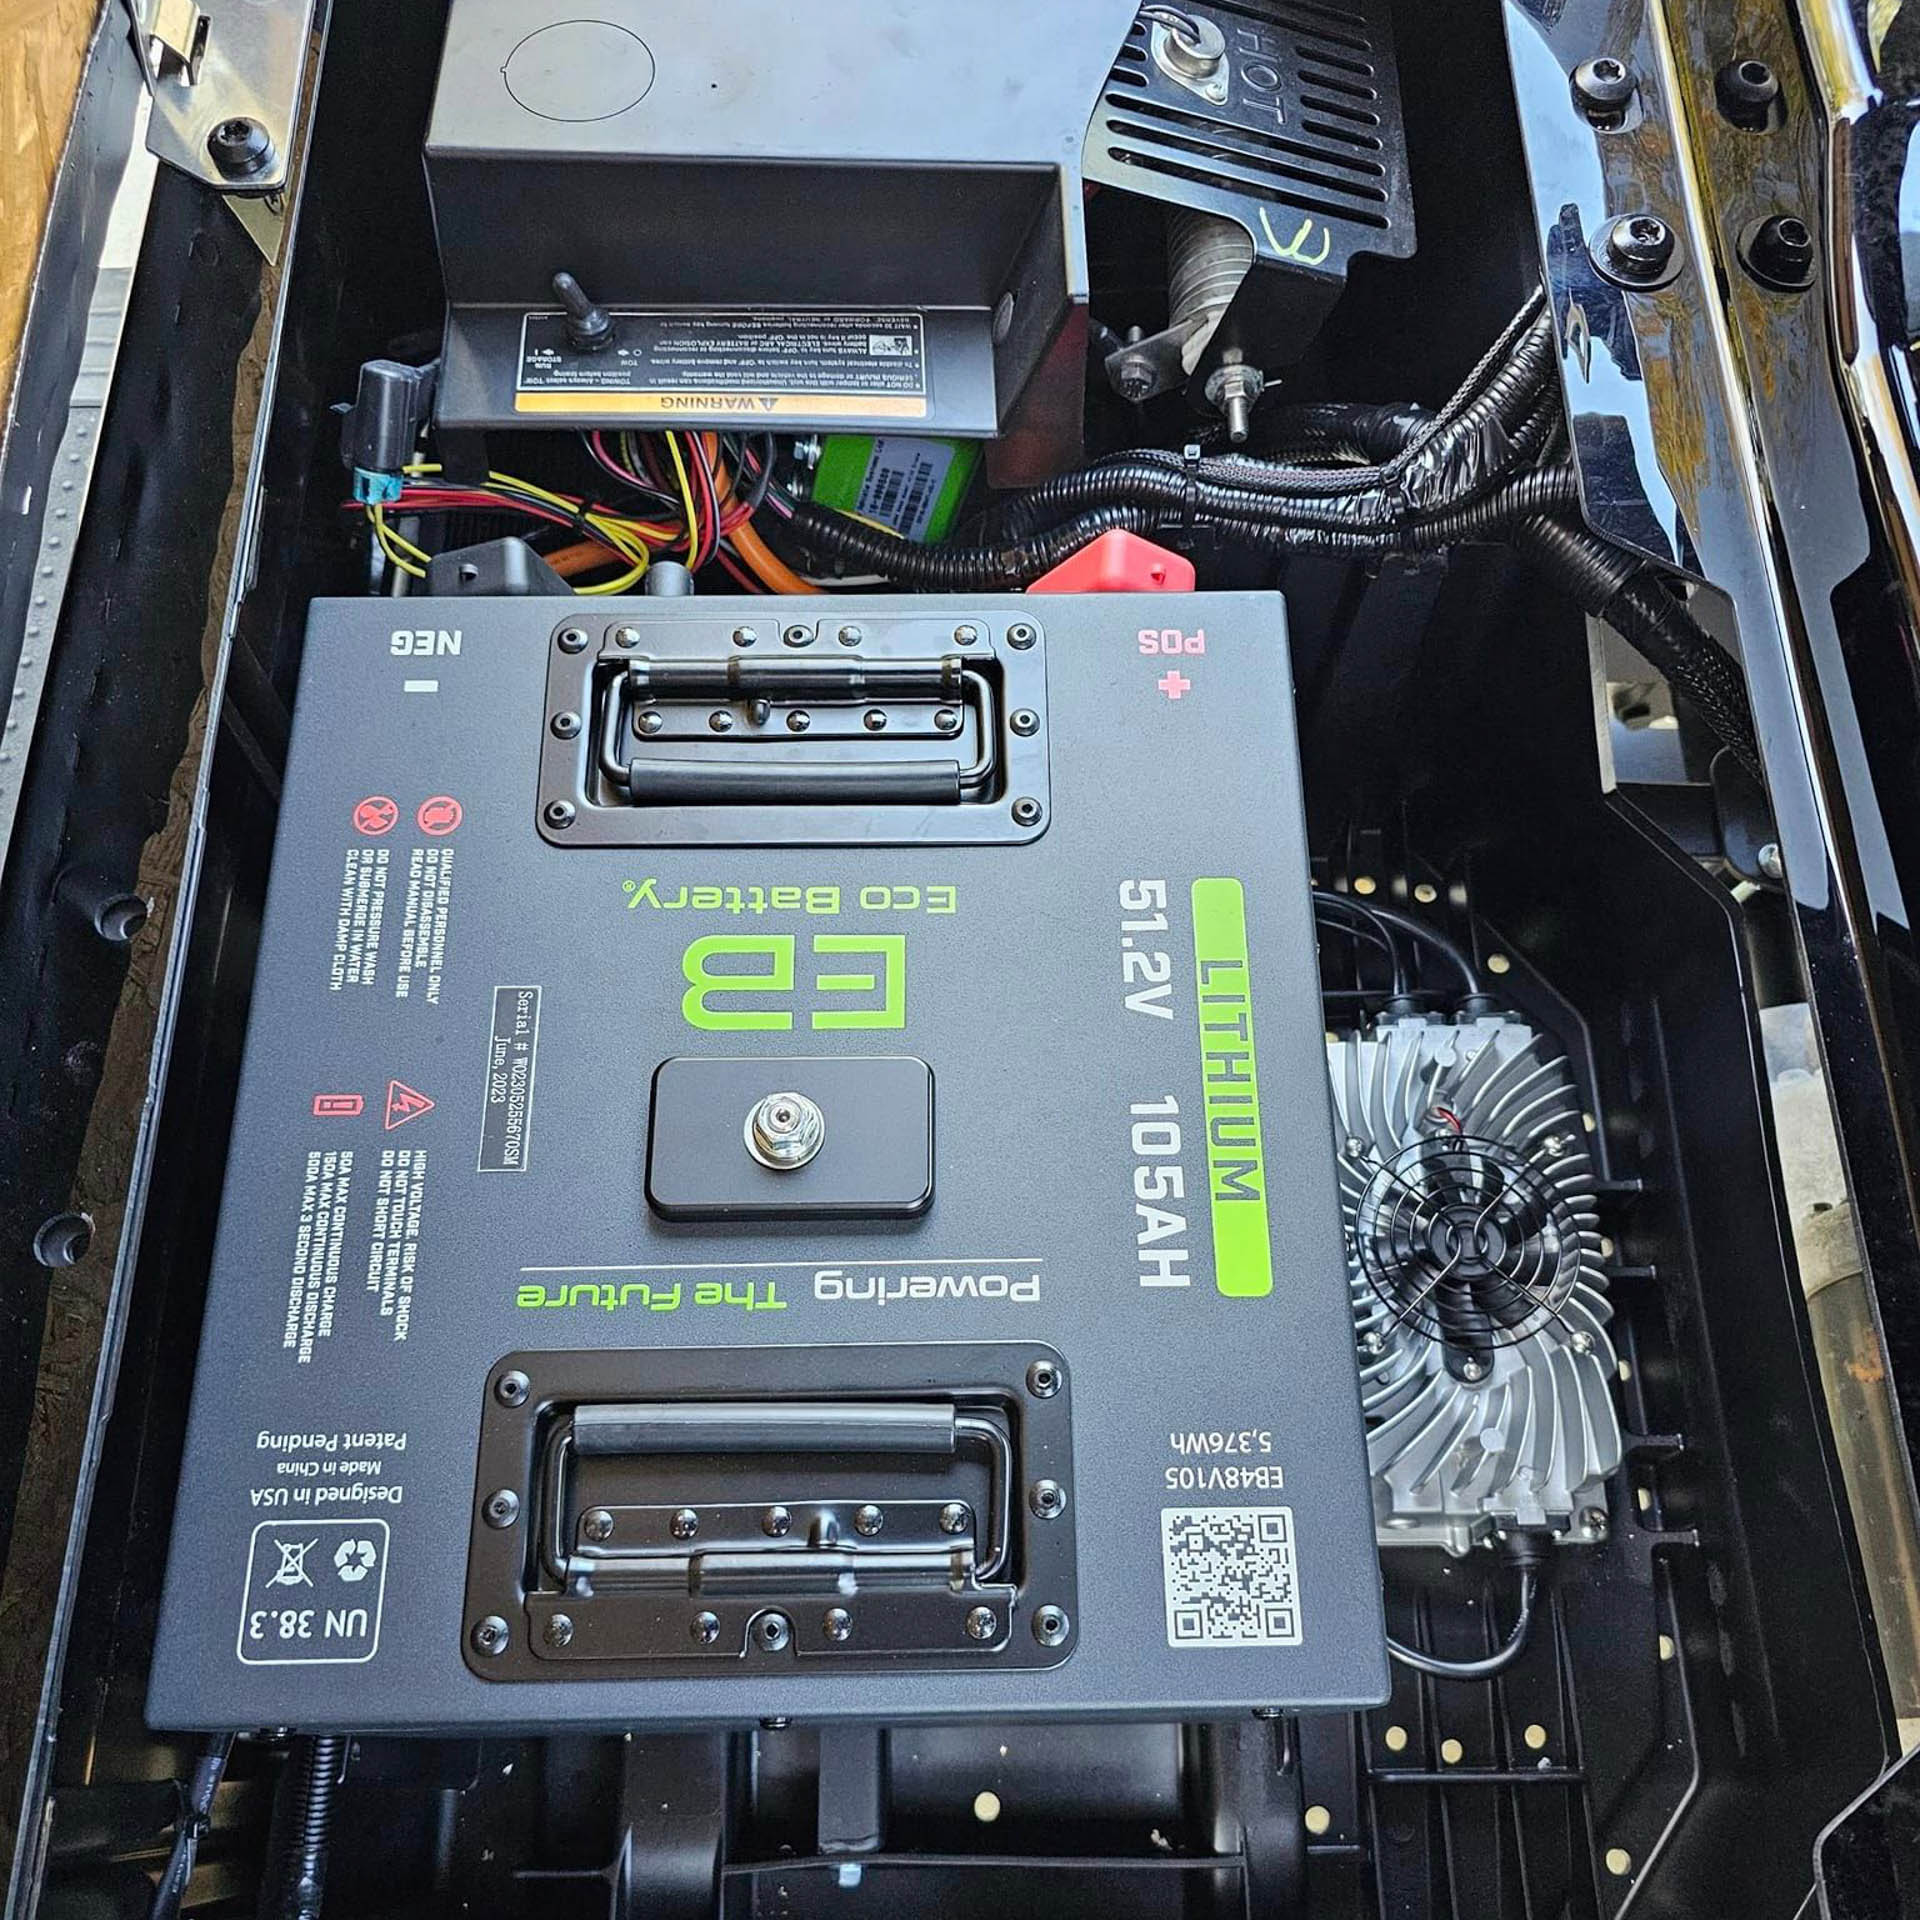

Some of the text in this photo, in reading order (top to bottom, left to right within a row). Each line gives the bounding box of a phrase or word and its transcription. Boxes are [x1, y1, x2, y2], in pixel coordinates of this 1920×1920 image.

[660, 396, 756, 409] WARNING
[390, 630, 463, 656] NEG
[1138, 629, 1205, 655] POS
[330, 849, 358, 990] CLEAN WITH DAMP CLOTH
[347, 849, 373, 982] OR SUBMERGE IN WATER
[363, 849, 388, 984] DO NOT PRESSURE WASH
[396, 849, 422, 997] READ MANUAL BEFORE USE
[415, 849, 438, 968] DO NOT DISASSEMBLE
[426, 849, 453, 1004] QUALIFIED PERSONNEL ONLY
[859, 885, 957, 914] Eco
[1119, 879, 1174, 1020] 51.2V
[515, 991, 531, 1035] Serial
[491, 1036, 509, 1103] June, 2023
[514, 1043, 527, 1051] #
[1200, 959, 1261, 1202] LITHIUM
[301, 1185, 316, 1212] MAX
[305, 1151, 320, 1182] 500A
[1130, 1094, 1191, 1288] 105AH
[293, 1225, 311, 1274] SECOND
[319, 1151, 352, 1336] 50A MAX CONTINUOUS CHARGE
[367, 1150, 393, 1292] DO NOT SHORT CIRCUIT
[381, 1150, 409, 1315] DO NOT TOUCH TERMINALS
[395, 1150, 425, 1341] HIGH VOLTAGE. RISK OF SHOCK
[299, 1151, 335, 1363] 150A MAX CONTINUOUS DISCHARGE
[284, 1277, 304, 1348] DISCHARGE
[515, 1270, 1041, 1312] Powering The Future
[256, 1430, 407, 1454] Patent Pending
[276, 1460, 382, 1477] Made in China
[250, 1482, 403, 1507] Designed in USA
[1165, 1466, 1284, 1490] EB48V105
[249, 1609, 368, 1640] UN 38.3
